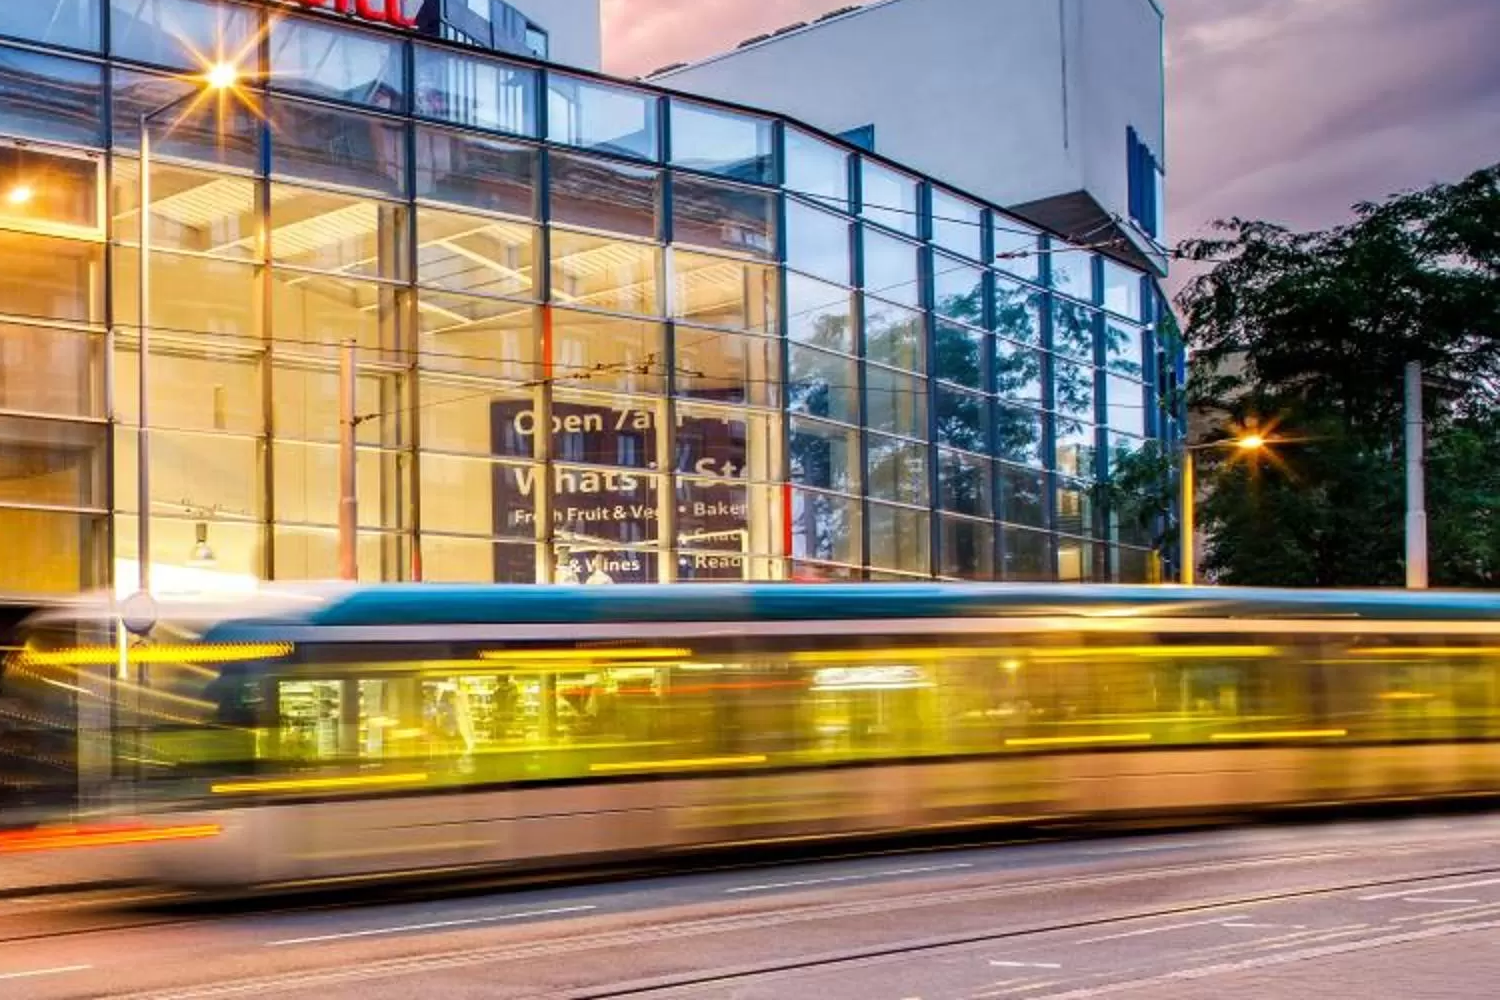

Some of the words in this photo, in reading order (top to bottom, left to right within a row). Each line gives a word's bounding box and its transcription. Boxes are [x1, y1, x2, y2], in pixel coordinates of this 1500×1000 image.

[515, 507, 563, 524] Frh
[567, 504, 609, 522] Fruit
[613, 505, 628, 520] &
